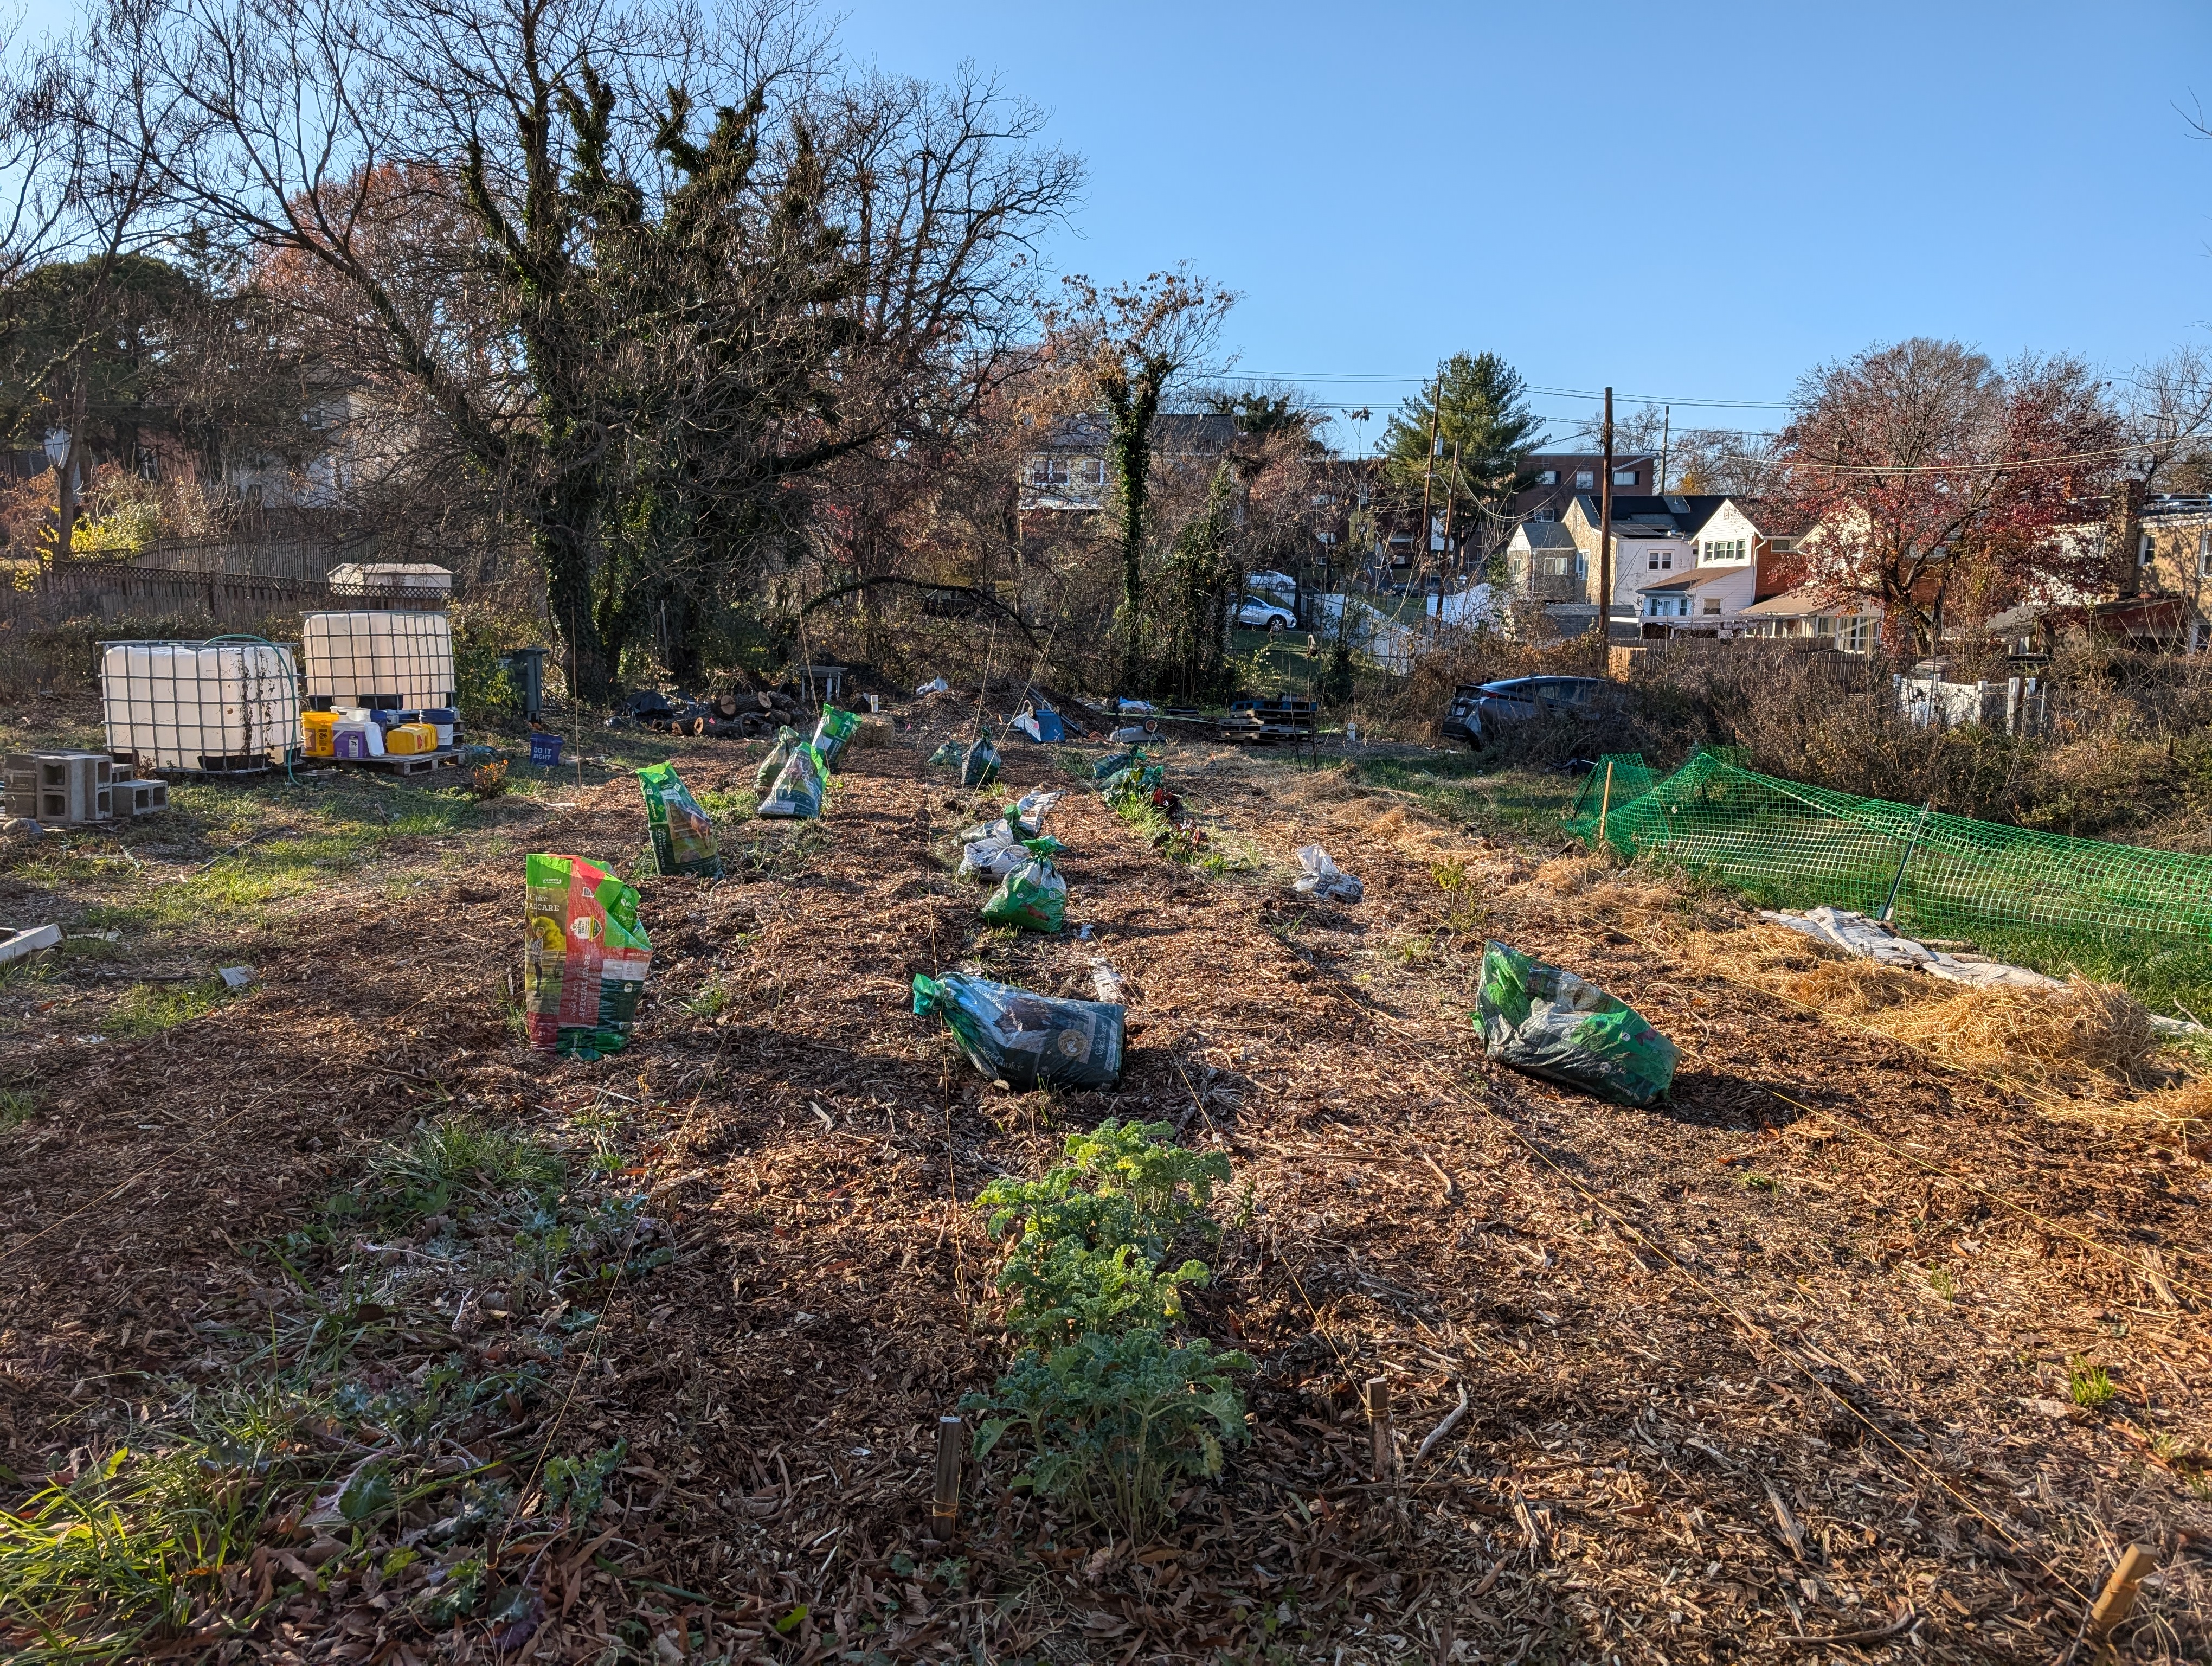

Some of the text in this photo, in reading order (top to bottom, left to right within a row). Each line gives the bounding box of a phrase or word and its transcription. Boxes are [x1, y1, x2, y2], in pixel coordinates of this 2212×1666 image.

[657, 828, 666, 868] MAINTENANCE
[537, 904, 560, 912] CARE
[569, 981, 579, 1017] SafeChoice
[578, 954, 591, 1018] SPECIAL CARE
[1095, 1023, 1108, 1059] SafeChoice
